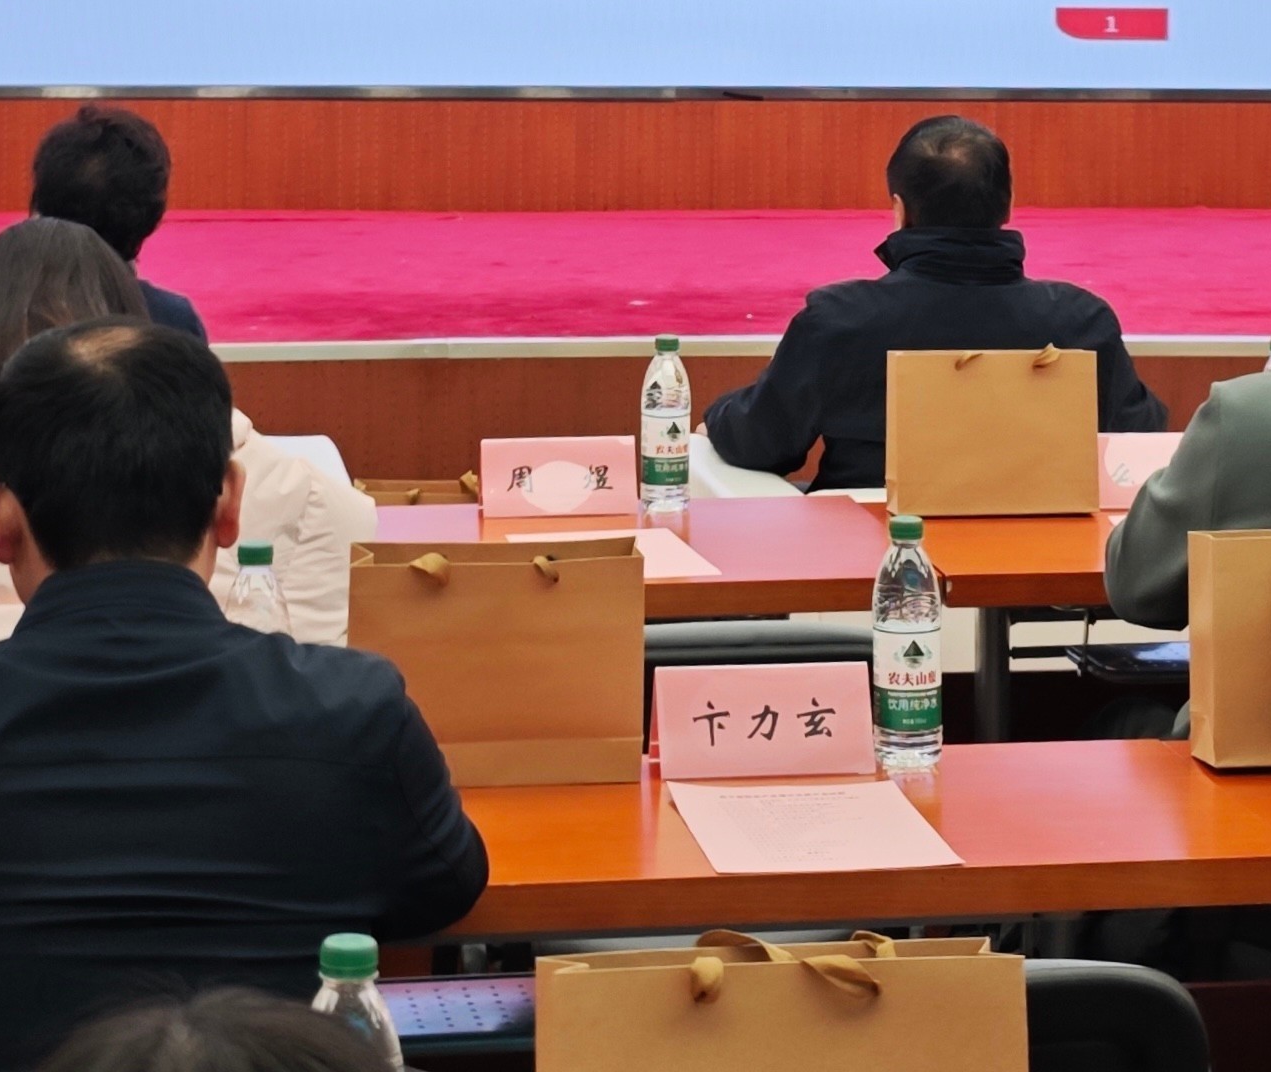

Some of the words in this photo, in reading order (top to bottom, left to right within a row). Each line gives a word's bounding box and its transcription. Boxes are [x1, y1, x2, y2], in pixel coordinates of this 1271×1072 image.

[1104, 15, 1120, 33] 1
[692, 697, 837, 747] 卞力玄
